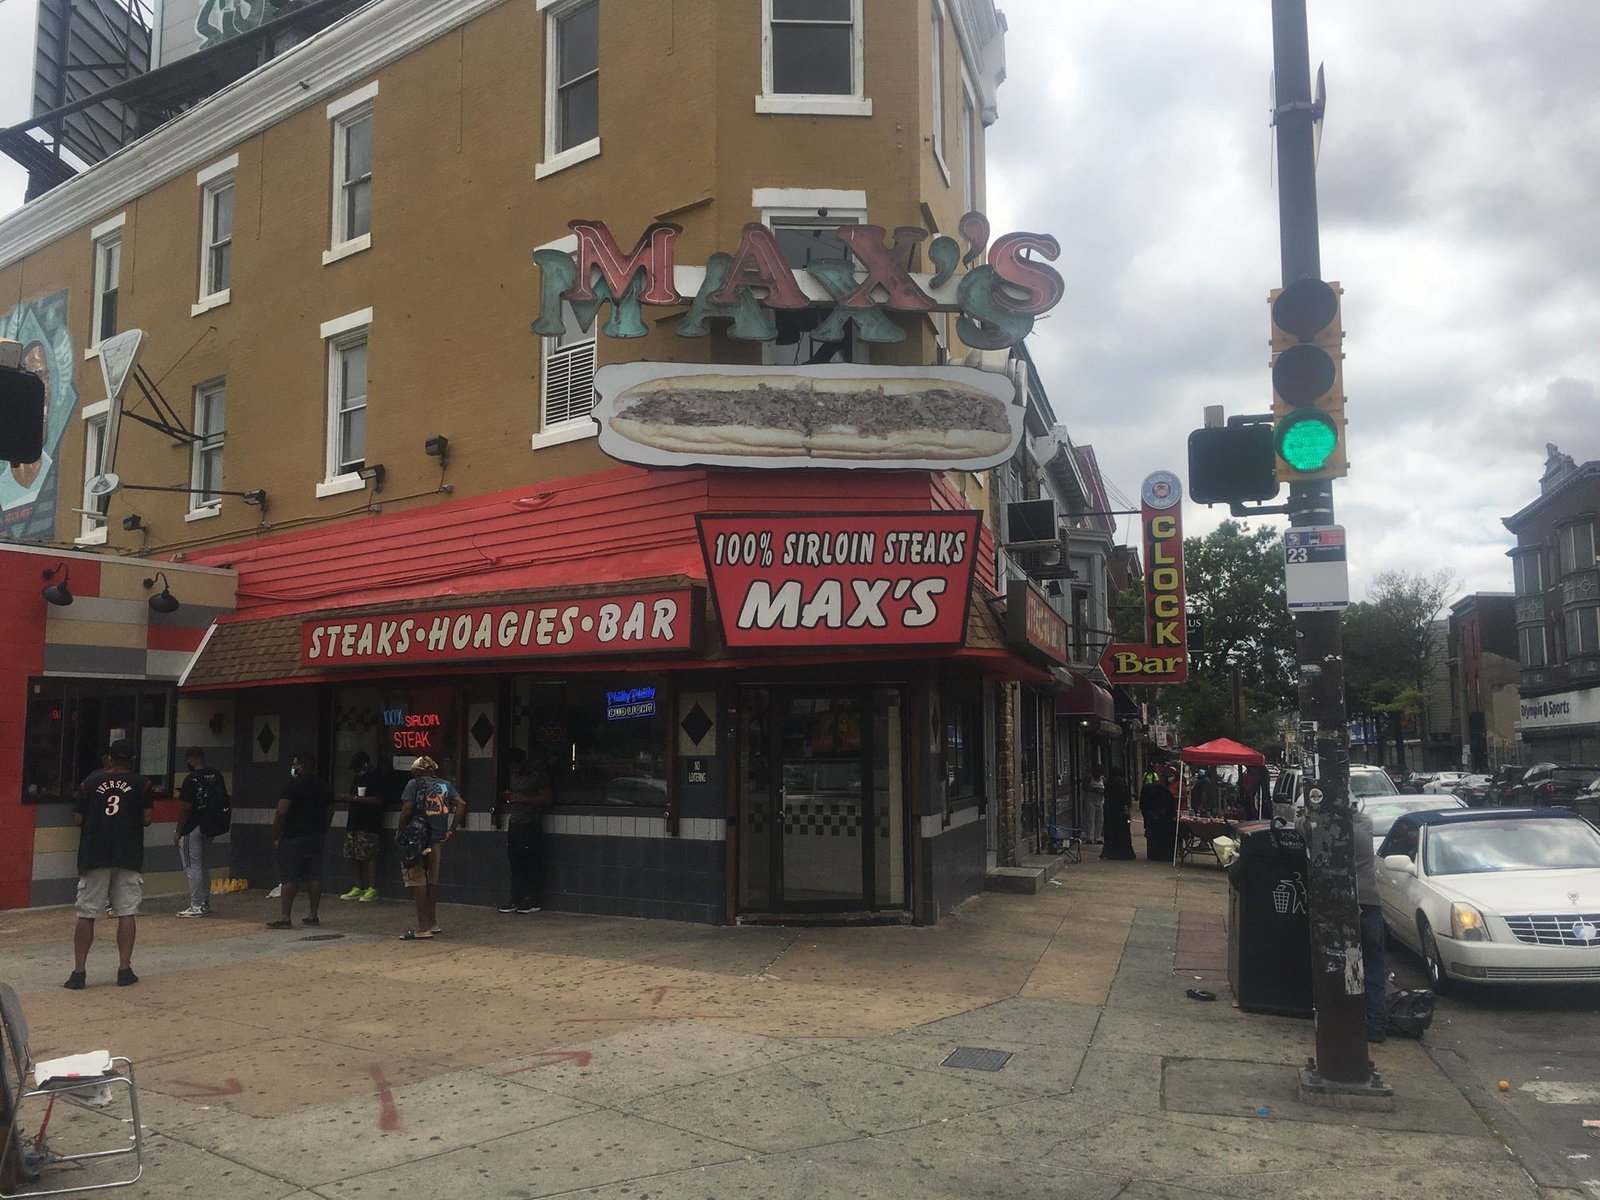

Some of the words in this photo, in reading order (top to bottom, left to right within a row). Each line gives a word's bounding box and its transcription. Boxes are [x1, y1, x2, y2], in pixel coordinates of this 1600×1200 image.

[566, 211, 1065, 314] MAX'S
[715, 532, 773, 566] 100%
[783, 532, 875, 566] SIRLOIN
[884, 531, 966, 565] STEAKS
[1287, 548, 1308, 563] 23
[1152, 515, 1181, 645] CLOCK
[738, 578, 946, 628] MAX'S
[309, 619, 415, 659] STEAKS
[427, 606, 580, 651] HOAGIES
[597, 598, 678, 643] BAR
[1114, 652, 1184, 675] Bar
[608, 706, 627, 718] BUD
[627, 702, 653, 716] LIGHT
[1548, 700, 1570, 718] Sports
[405, 713, 440, 728] SIRLOIN
[393, 731, 431, 749] STEAK
[96, 780, 132, 795] IVERSON
[105, 795, 120, 816] 3
